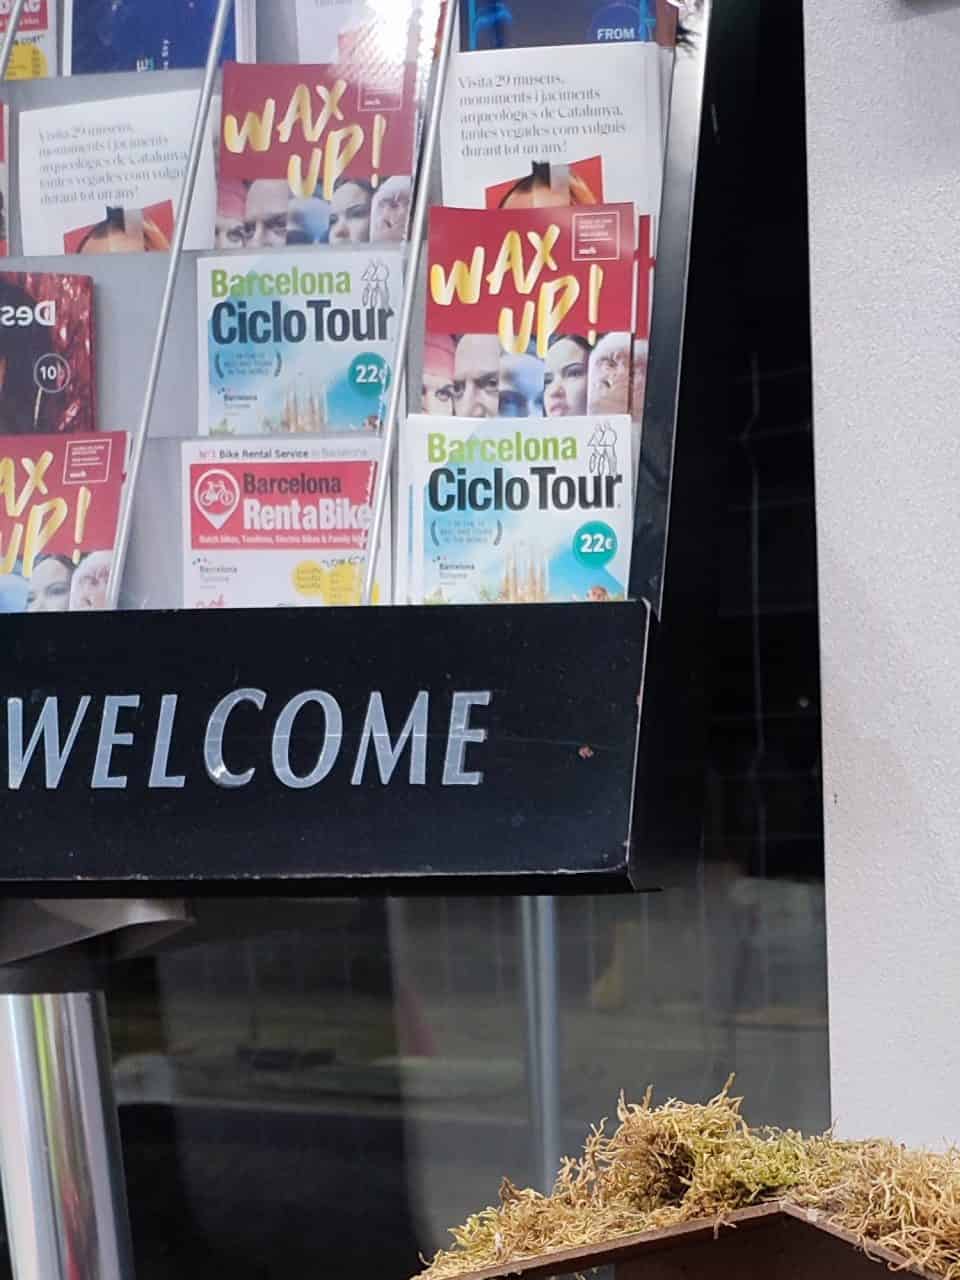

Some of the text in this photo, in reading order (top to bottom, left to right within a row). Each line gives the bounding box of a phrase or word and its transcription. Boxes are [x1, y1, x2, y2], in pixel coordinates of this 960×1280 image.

[597, 27, 635, 41] FROM
[458, 77, 492, 88] Visita
[495, 75, 510, 87] 29
[225, 80, 346, 153] WAX
[287, 114, 387, 200] UP!
[211, 269, 350, 298] Barcelona
[430, 224, 560, 306] WAX
[212, 300, 394, 345] CicloTour
[499, 264, 602, 358] UP!
[219, 448, 239, 459] Bike
[242, 448, 272, 459] Rental
[275, 448, 308, 459] Service
[428, 431, 577, 463] Barcelona
[0, 451, 54, 517] AX
[243, 473, 342, 494] Barcelona
[428, 467, 623, 512] CicloTour
[580, 534, 614, 553] 22€
[7, 687, 491, 791] WELCOME
